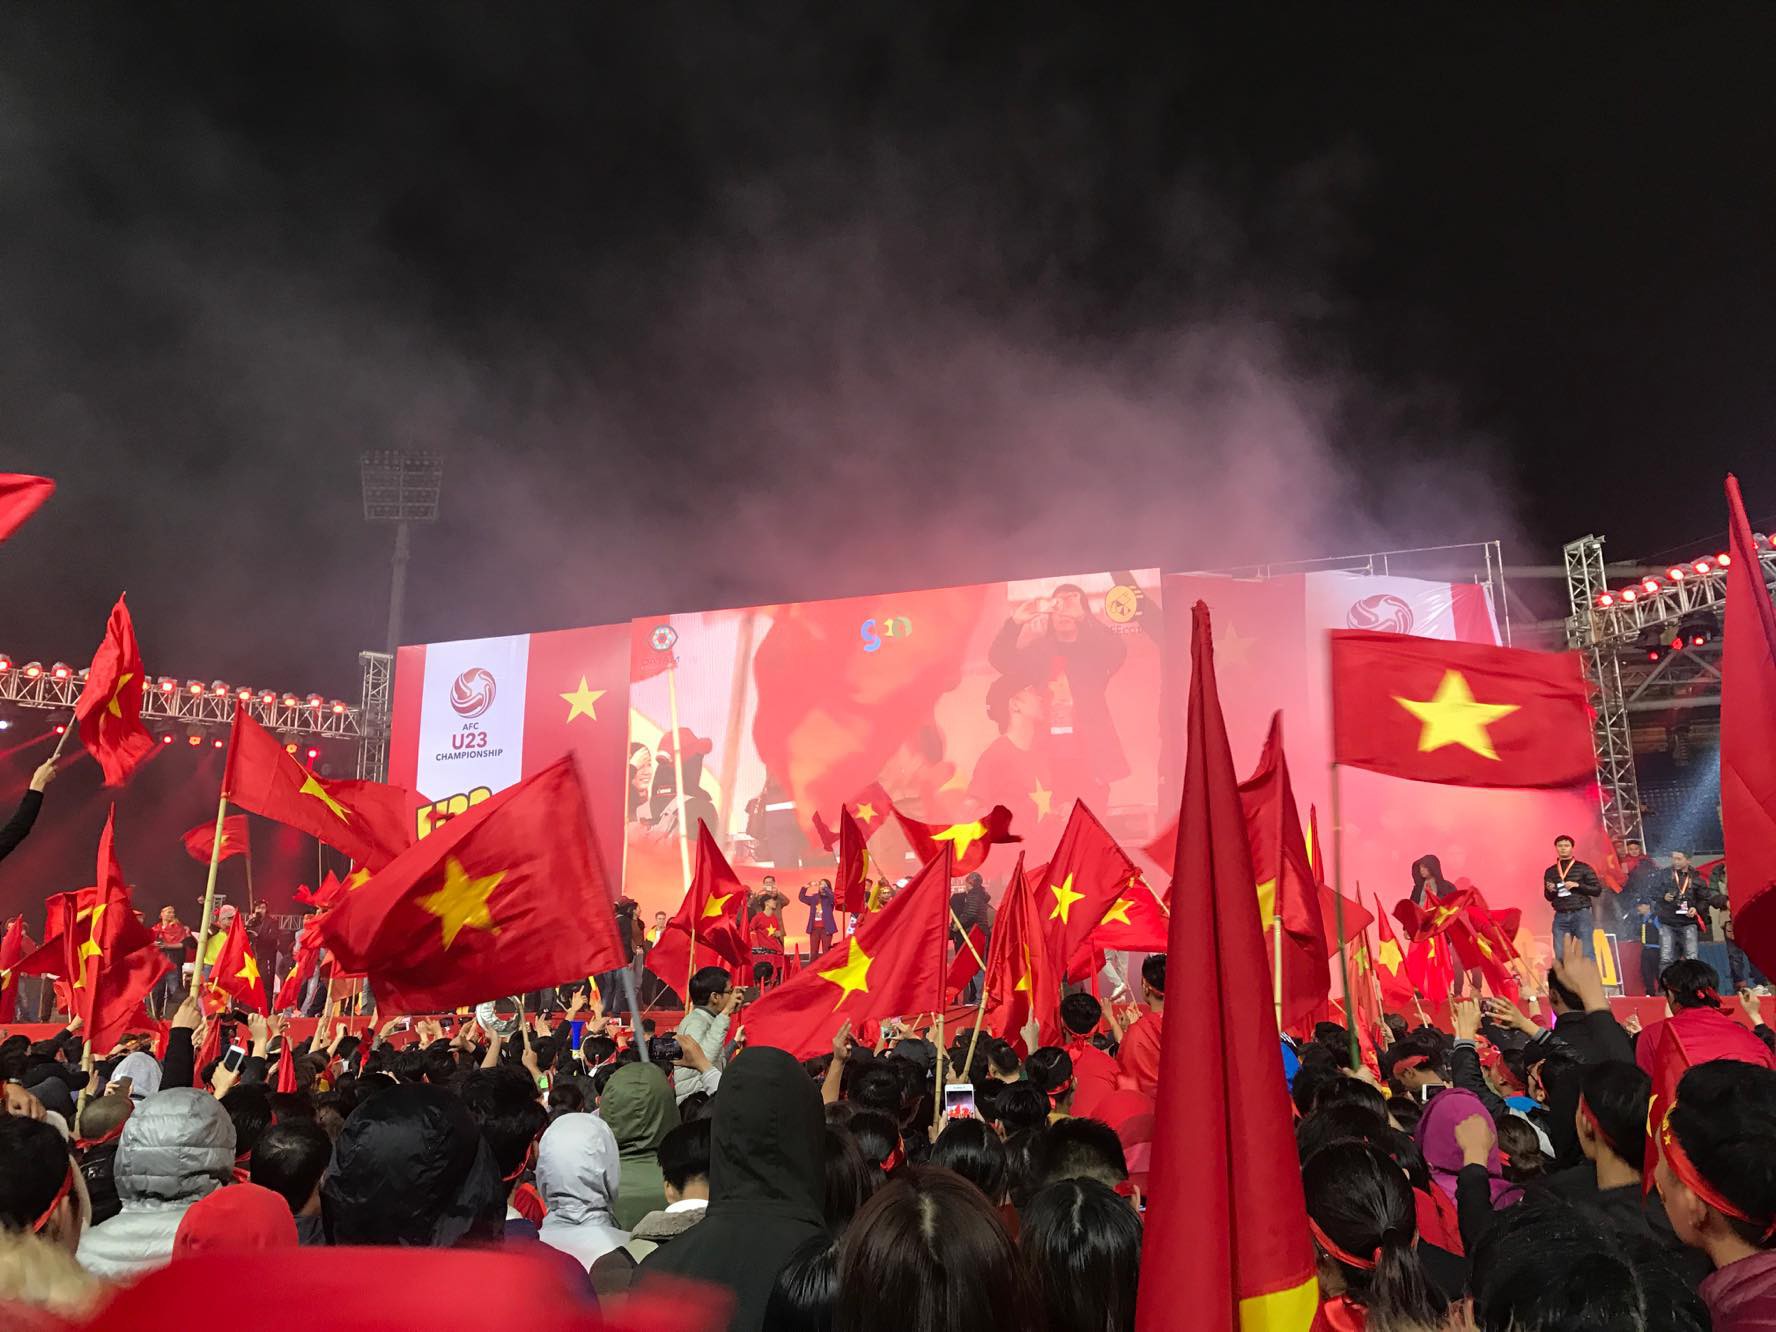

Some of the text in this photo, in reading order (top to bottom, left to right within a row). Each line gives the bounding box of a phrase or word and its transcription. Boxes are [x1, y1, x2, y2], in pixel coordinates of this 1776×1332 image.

[462, 722, 479, 731] AFC
[452, 731, 488, 750] U23
[435, 748, 503, 761] CHAMPIONSHIP
